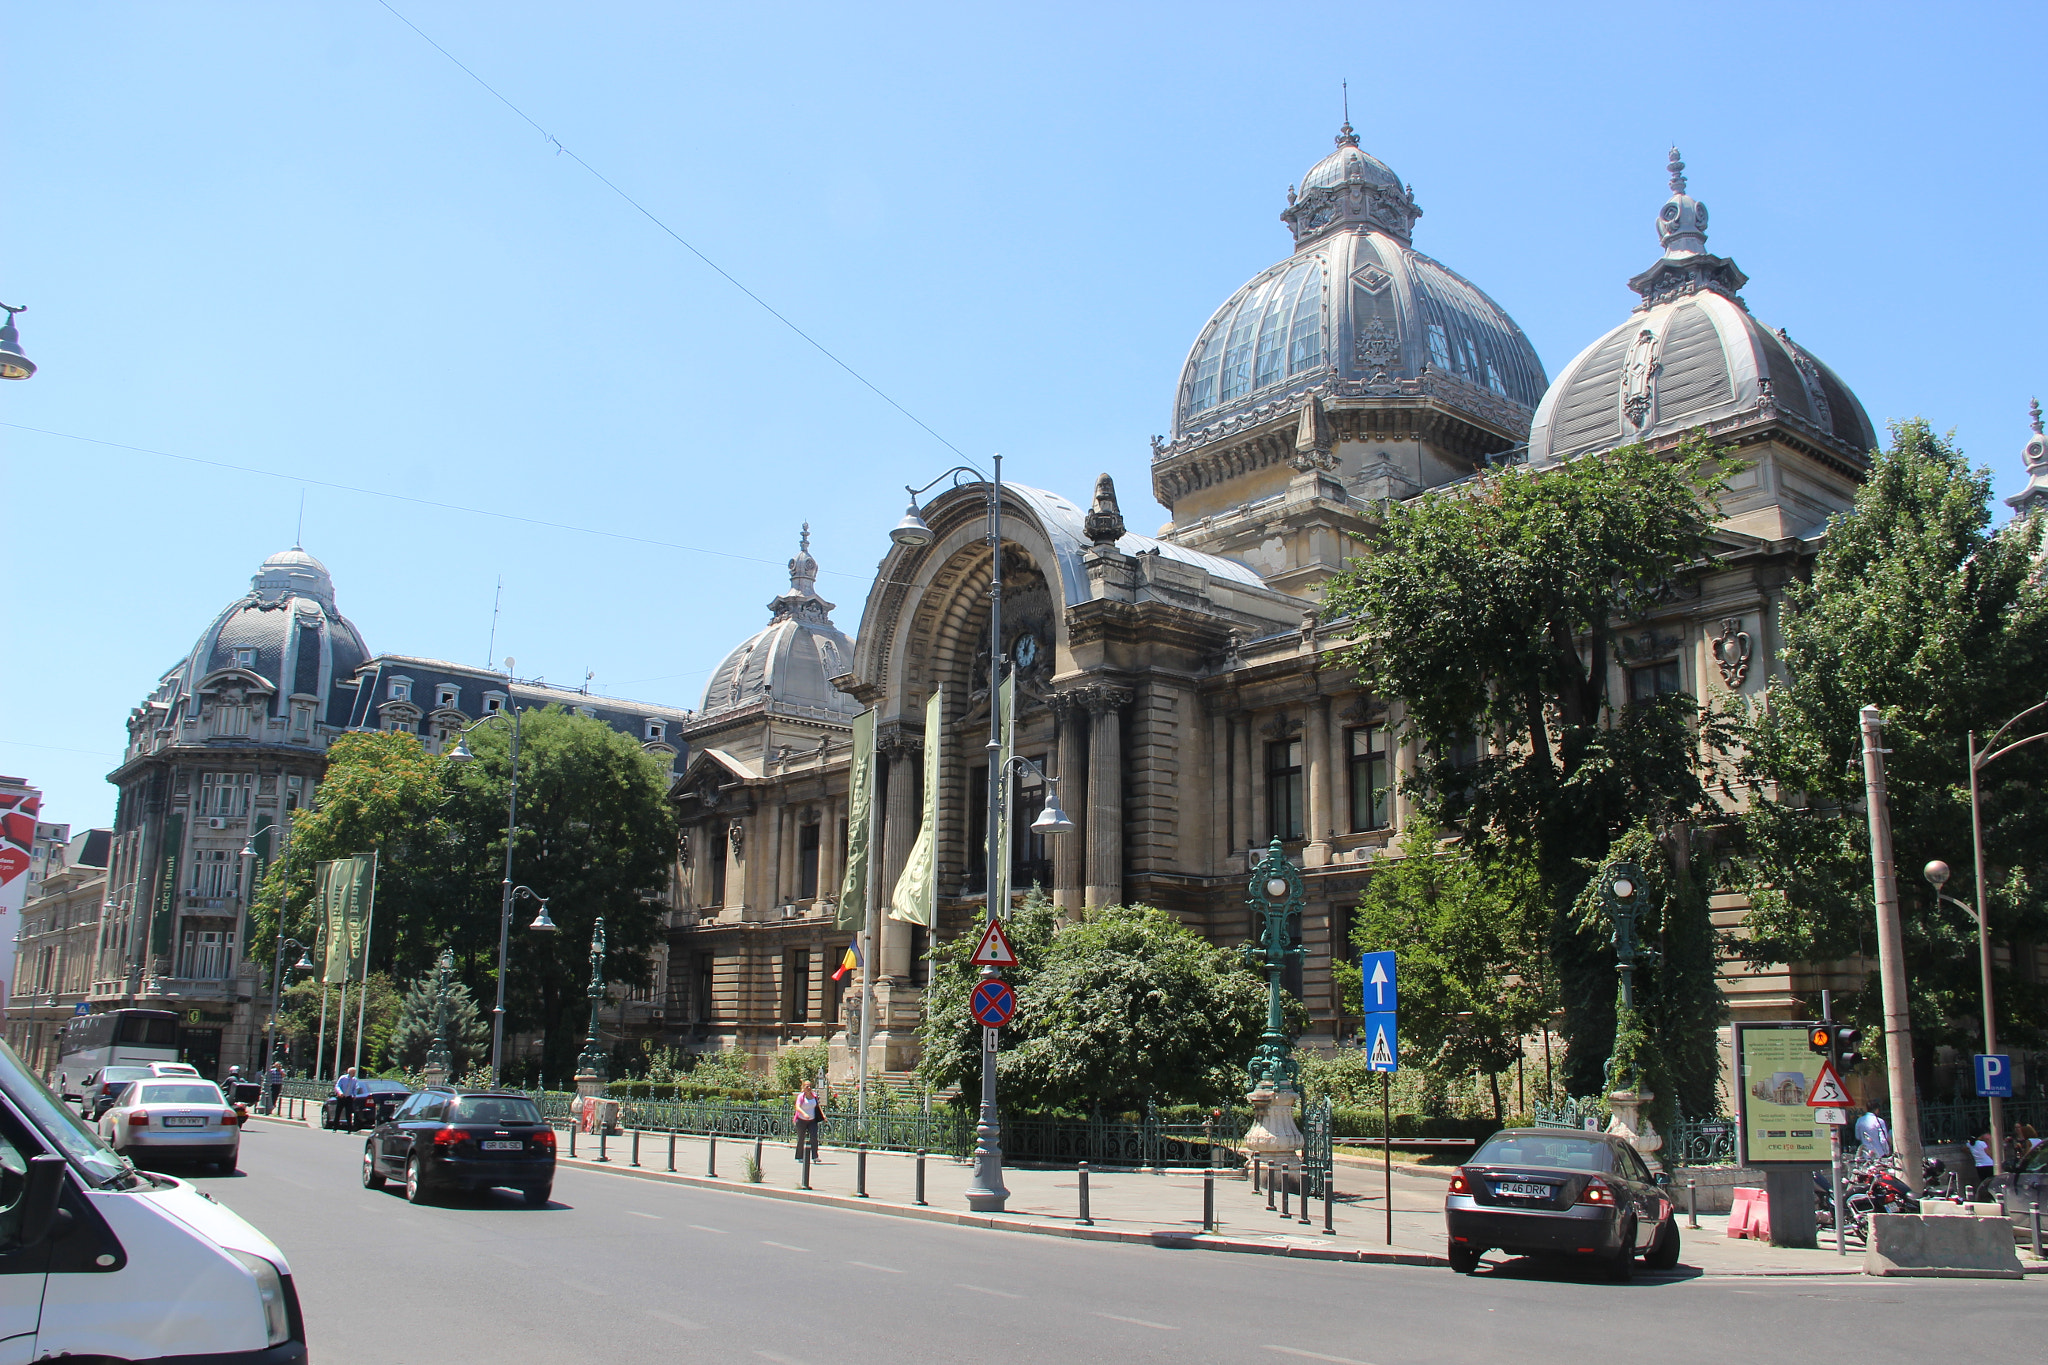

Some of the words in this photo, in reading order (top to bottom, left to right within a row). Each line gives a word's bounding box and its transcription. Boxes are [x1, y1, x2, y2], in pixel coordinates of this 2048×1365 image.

[165, 855, 175, 880] Bank
[161, 891, 171, 912] CEC
[1982, 1056, 2002, 1090] P
[1502, 1183, 1509, 1192] B
[1511, 1184, 1523, 1193] 46
[1525, 1185, 1546, 1195] DRK
